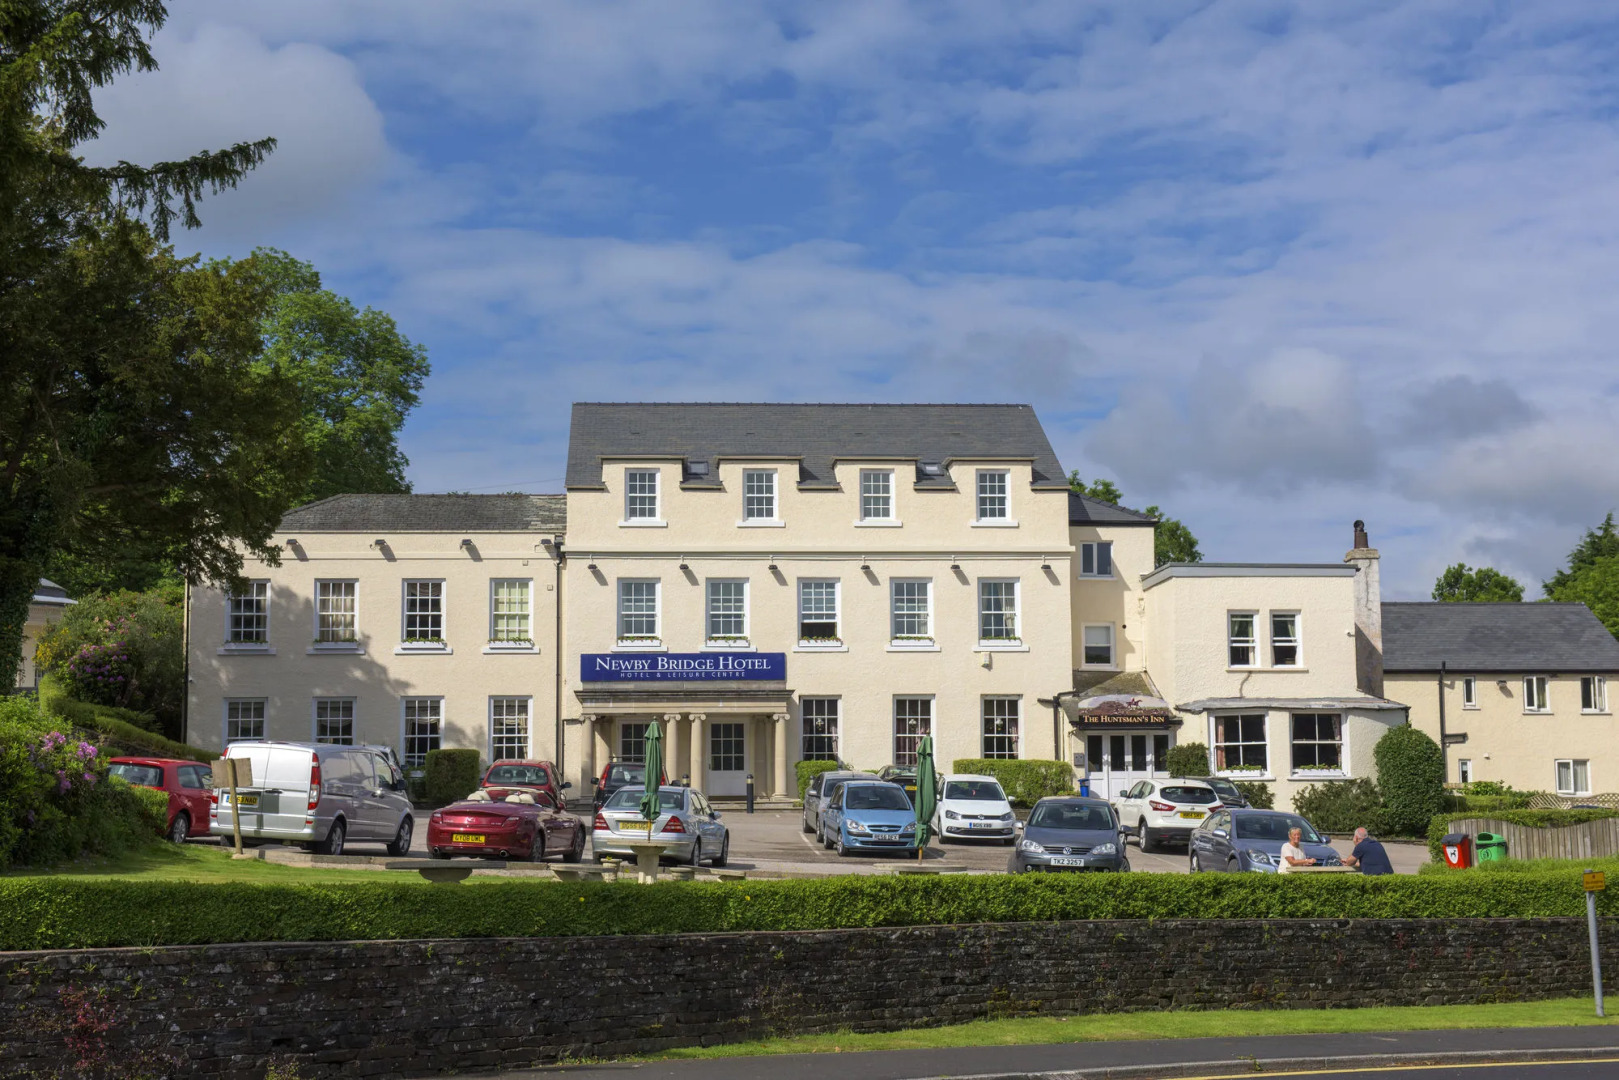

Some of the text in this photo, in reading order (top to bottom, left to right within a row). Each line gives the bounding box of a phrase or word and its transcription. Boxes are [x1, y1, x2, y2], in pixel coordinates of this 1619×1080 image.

[595, 656, 771, 671] NEWBY BRIDGE HOTEL
[1083, 715, 1099, 723] THE
[1150, 715, 1165, 723] INN
[1067, 858, 1082, 866] 3257
